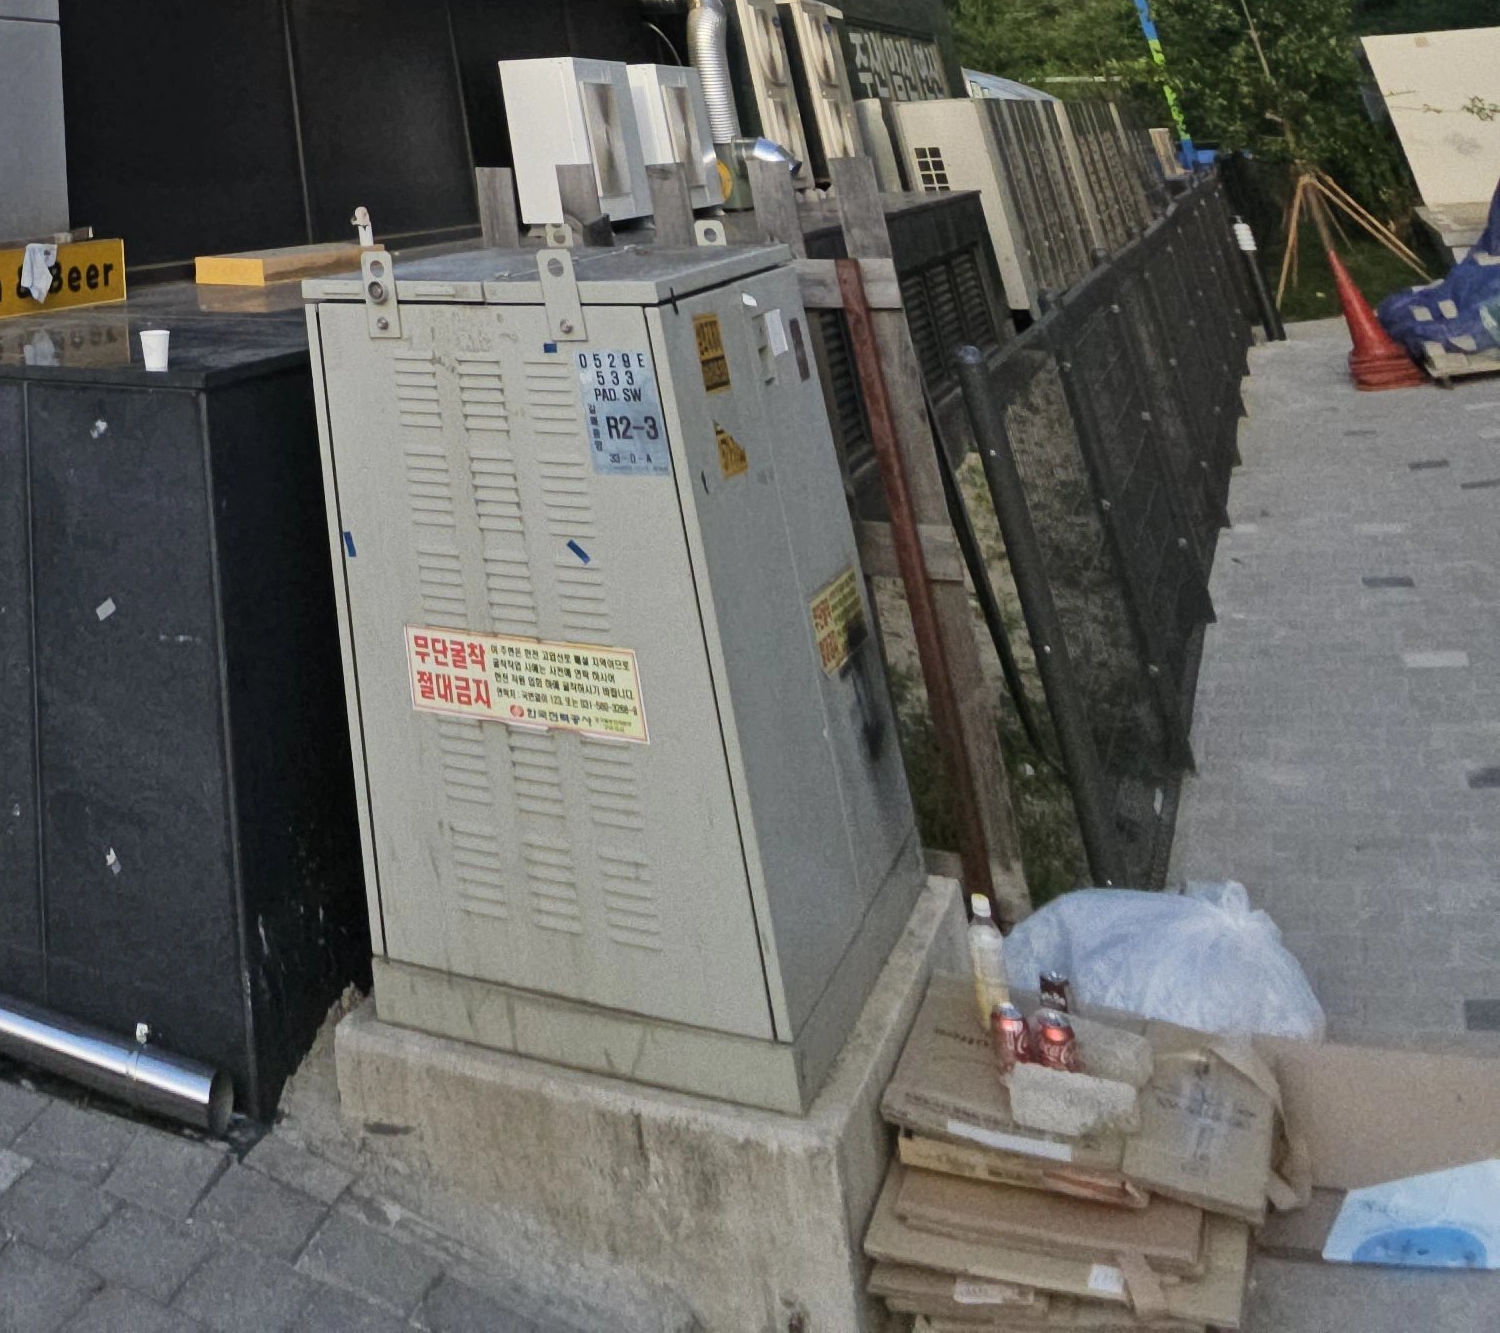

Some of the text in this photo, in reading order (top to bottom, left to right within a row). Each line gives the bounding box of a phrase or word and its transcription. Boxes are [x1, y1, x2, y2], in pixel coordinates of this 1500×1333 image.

[622, 388, 642, 402] SW
[606, 416, 658, 440] R2-3
[414, 635, 486, 672] 무단굴착
[490, 645, 498, 654] 이
[525, 646, 539, 658] 한전
[417, 671, 491, 709] 절대금지
